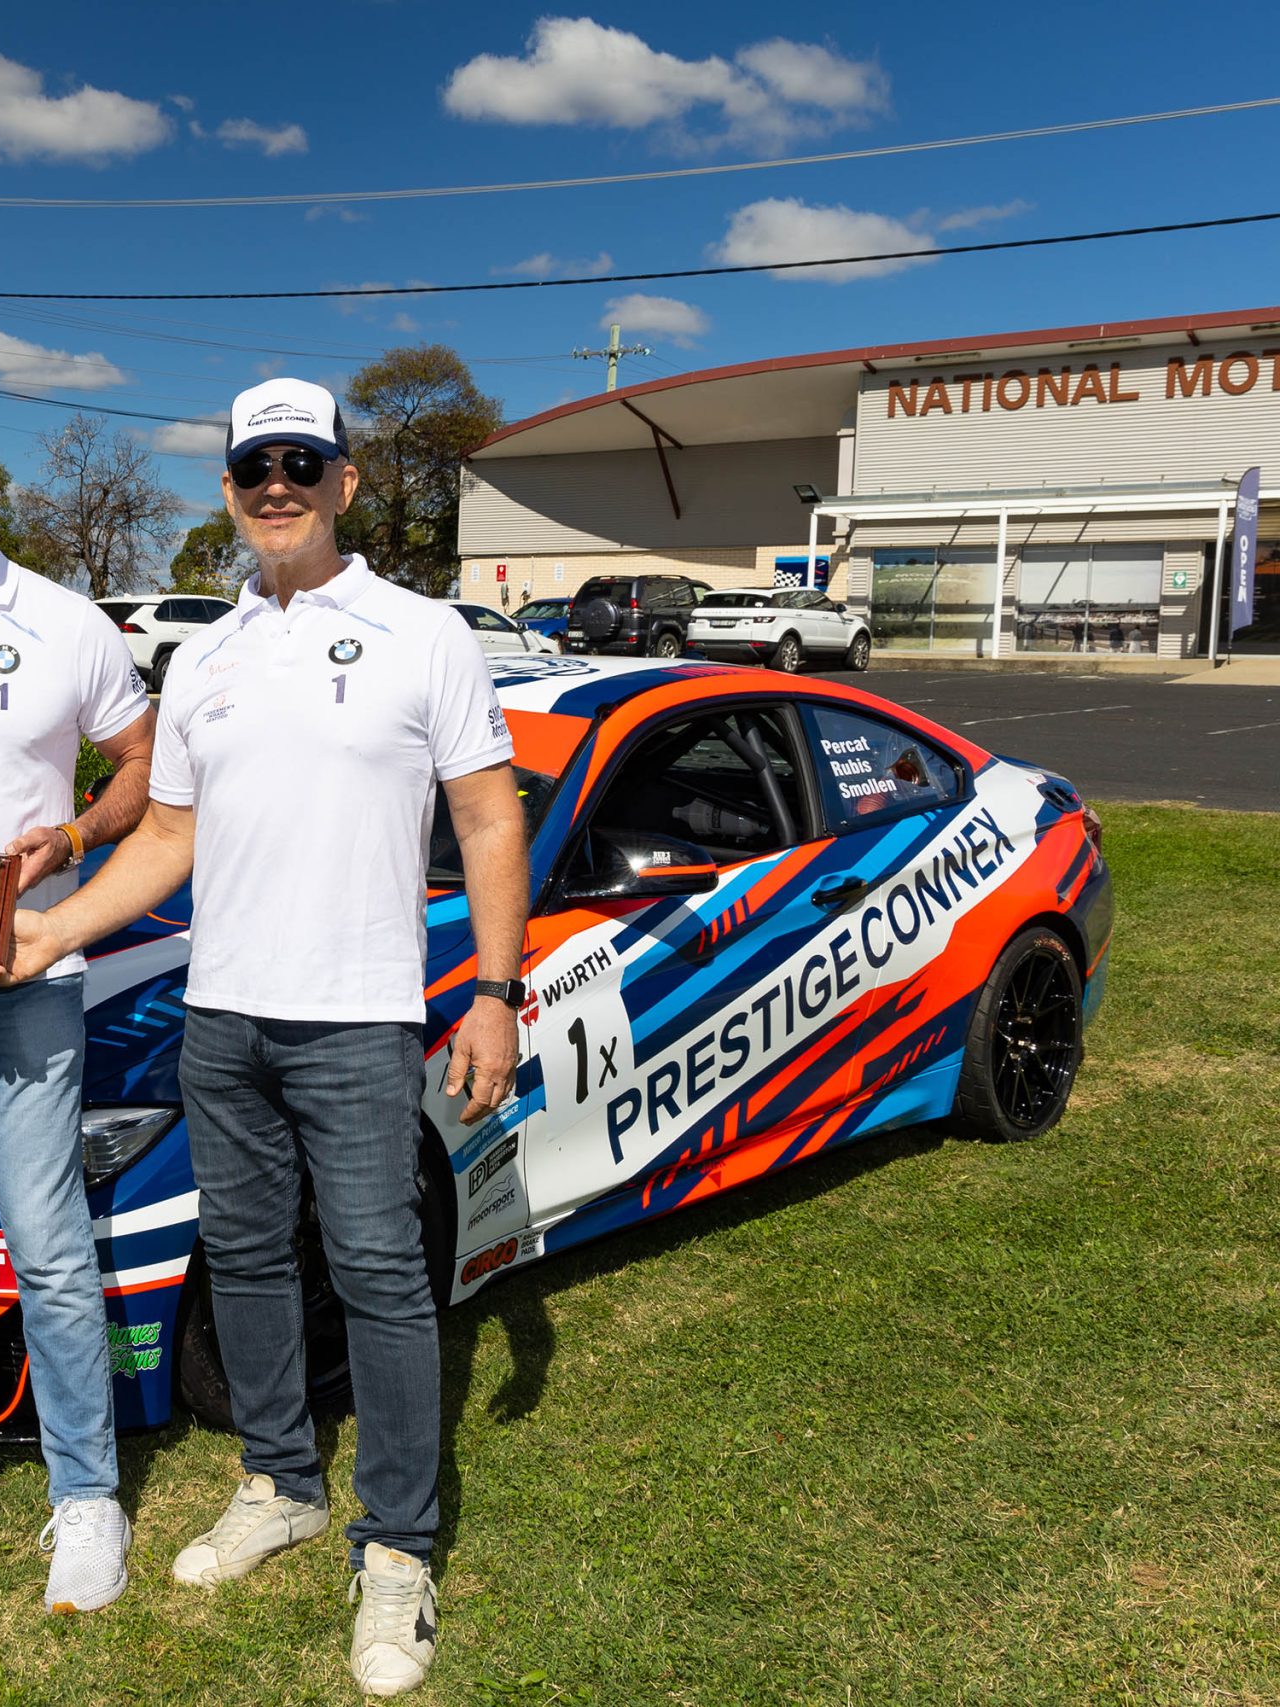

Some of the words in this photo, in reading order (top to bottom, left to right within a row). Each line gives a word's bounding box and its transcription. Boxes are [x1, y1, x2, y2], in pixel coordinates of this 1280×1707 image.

[888, 362, 1140, 418] NATIONAL
[251, 416, 283, 426] PRESTIGE
[285, 416, 316, 425] CONNEX
[1237, 534, 1249, 603] OPEN
[331, 674, 347, 704] 1
[820, 735, 871, 755] Percat
[830, 758, 872, 777] Rubis
[839, 778, 898, 799] Smollen
[542, 946, 612, 1008] WÜRTH
[461, 1237, 518, 1286] CIRCO
[521, 1245, 536, 1257] PADS
[106, 1321, 163, 1349] hanes
